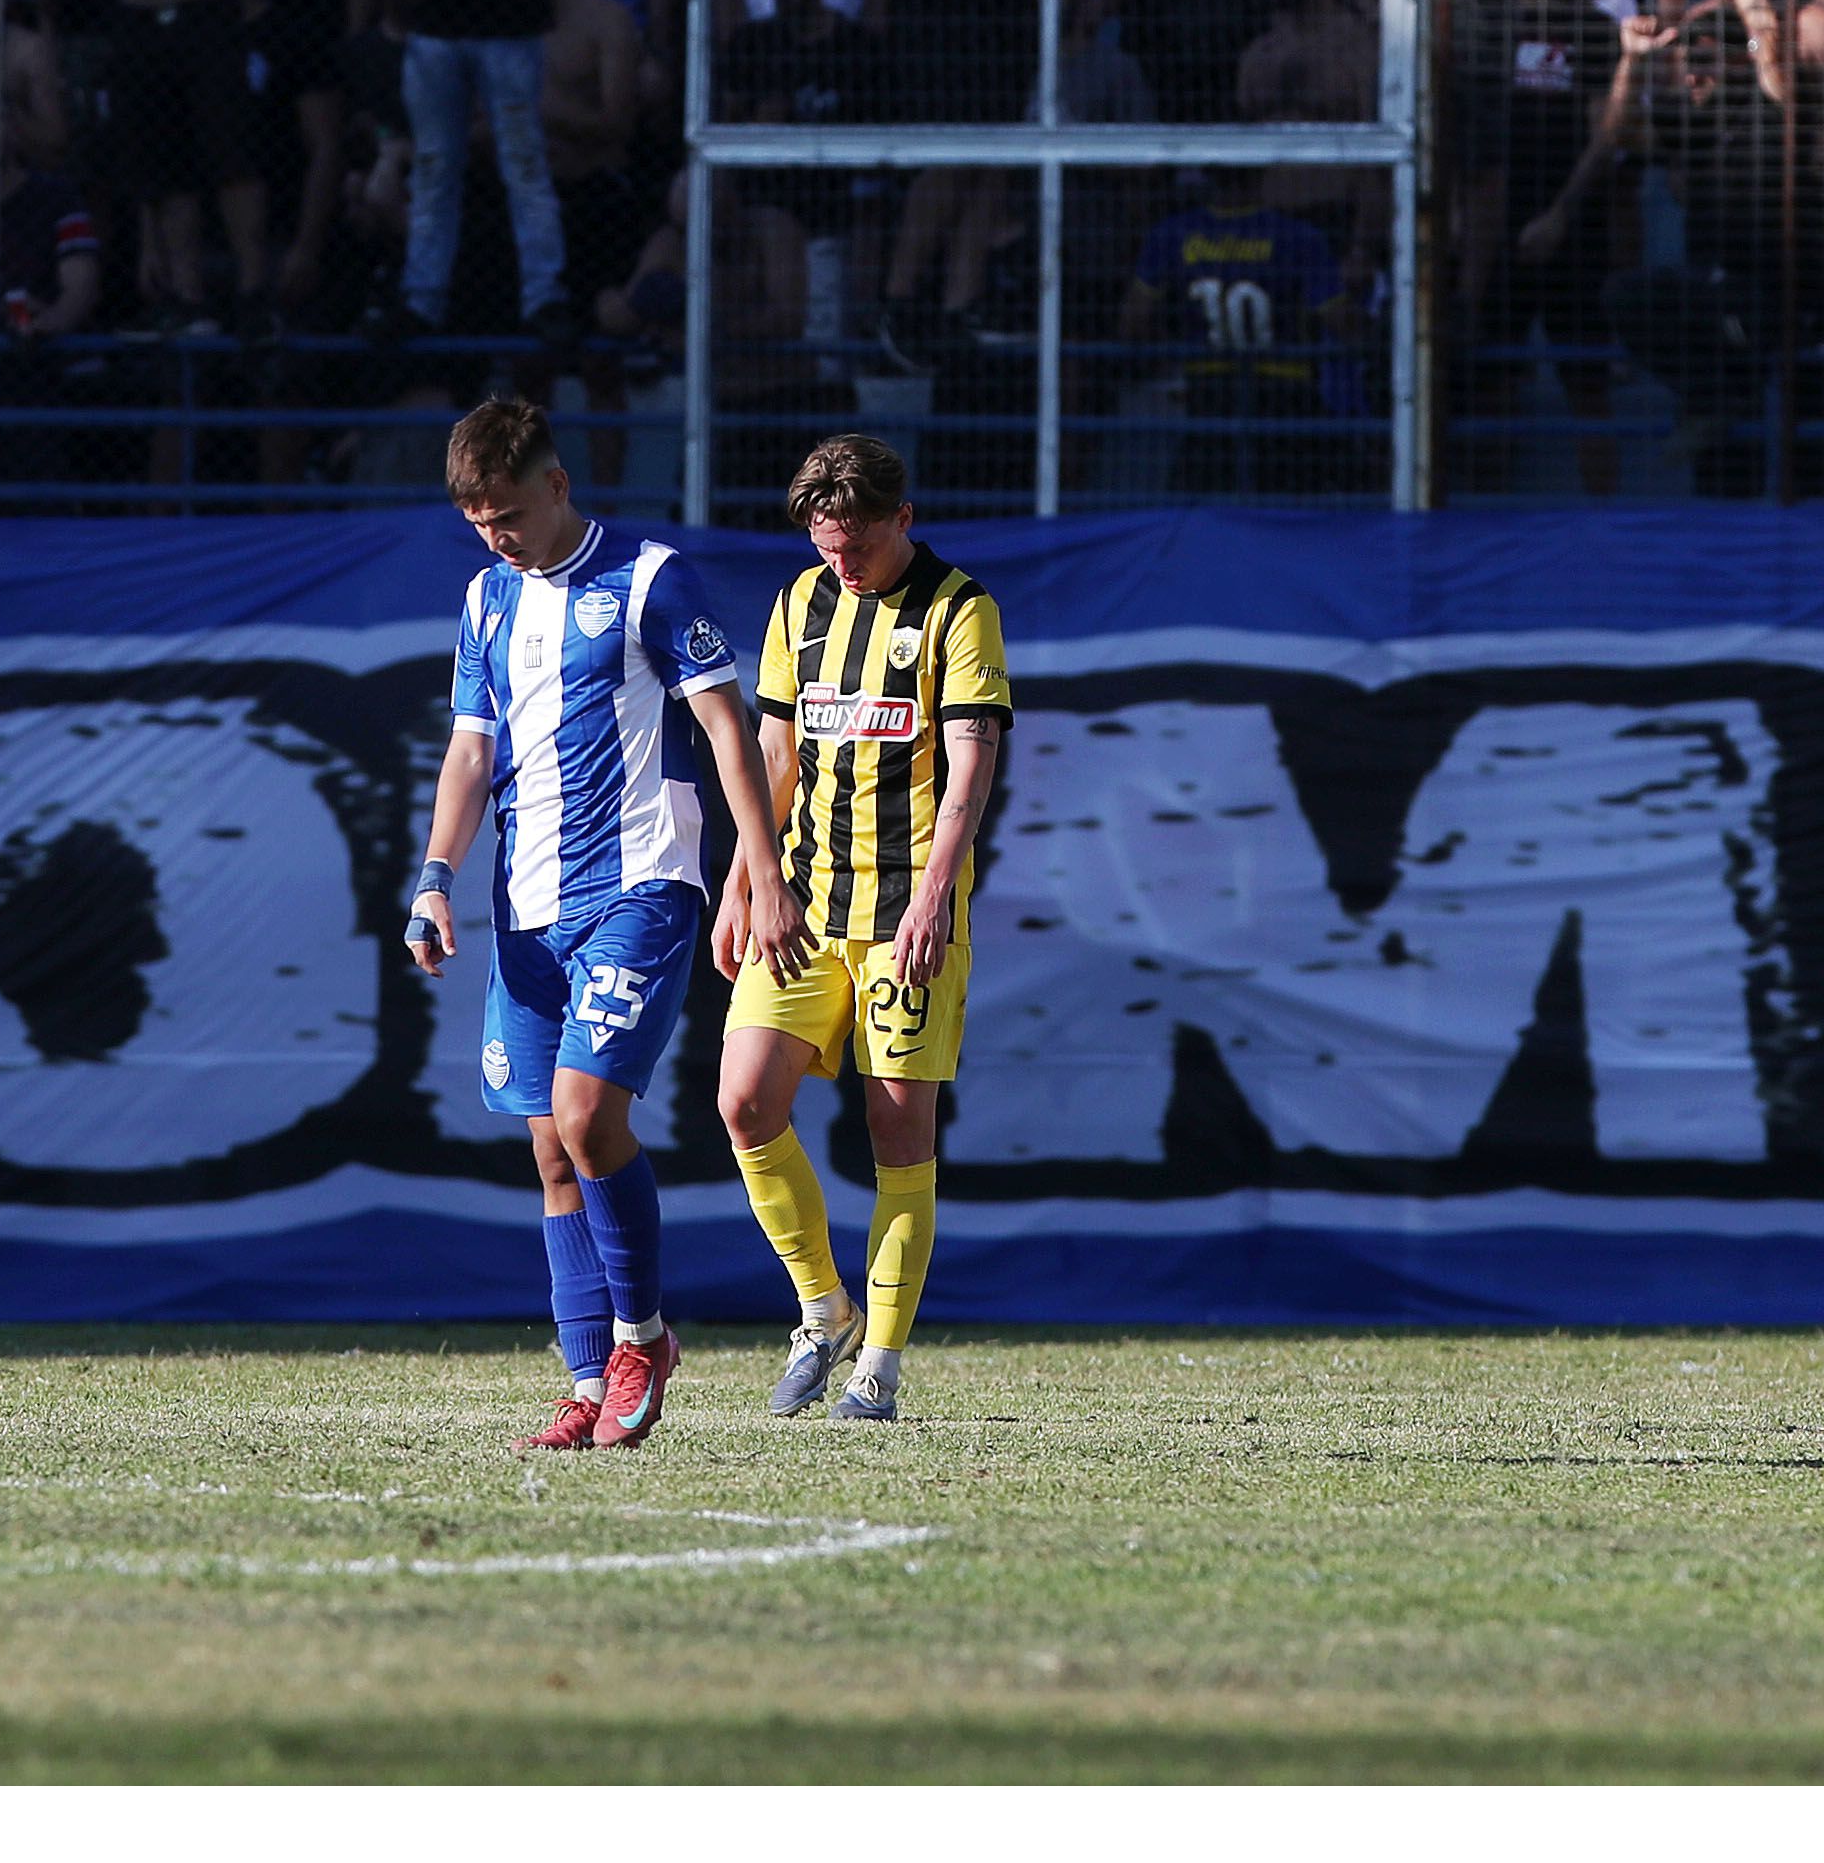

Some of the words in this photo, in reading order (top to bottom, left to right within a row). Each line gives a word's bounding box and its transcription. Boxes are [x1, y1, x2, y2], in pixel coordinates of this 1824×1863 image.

[1188, 277, 1274, 352] 10
[576, 965, 648, 1030] 25
[870, 978, 930, 1036] 29
